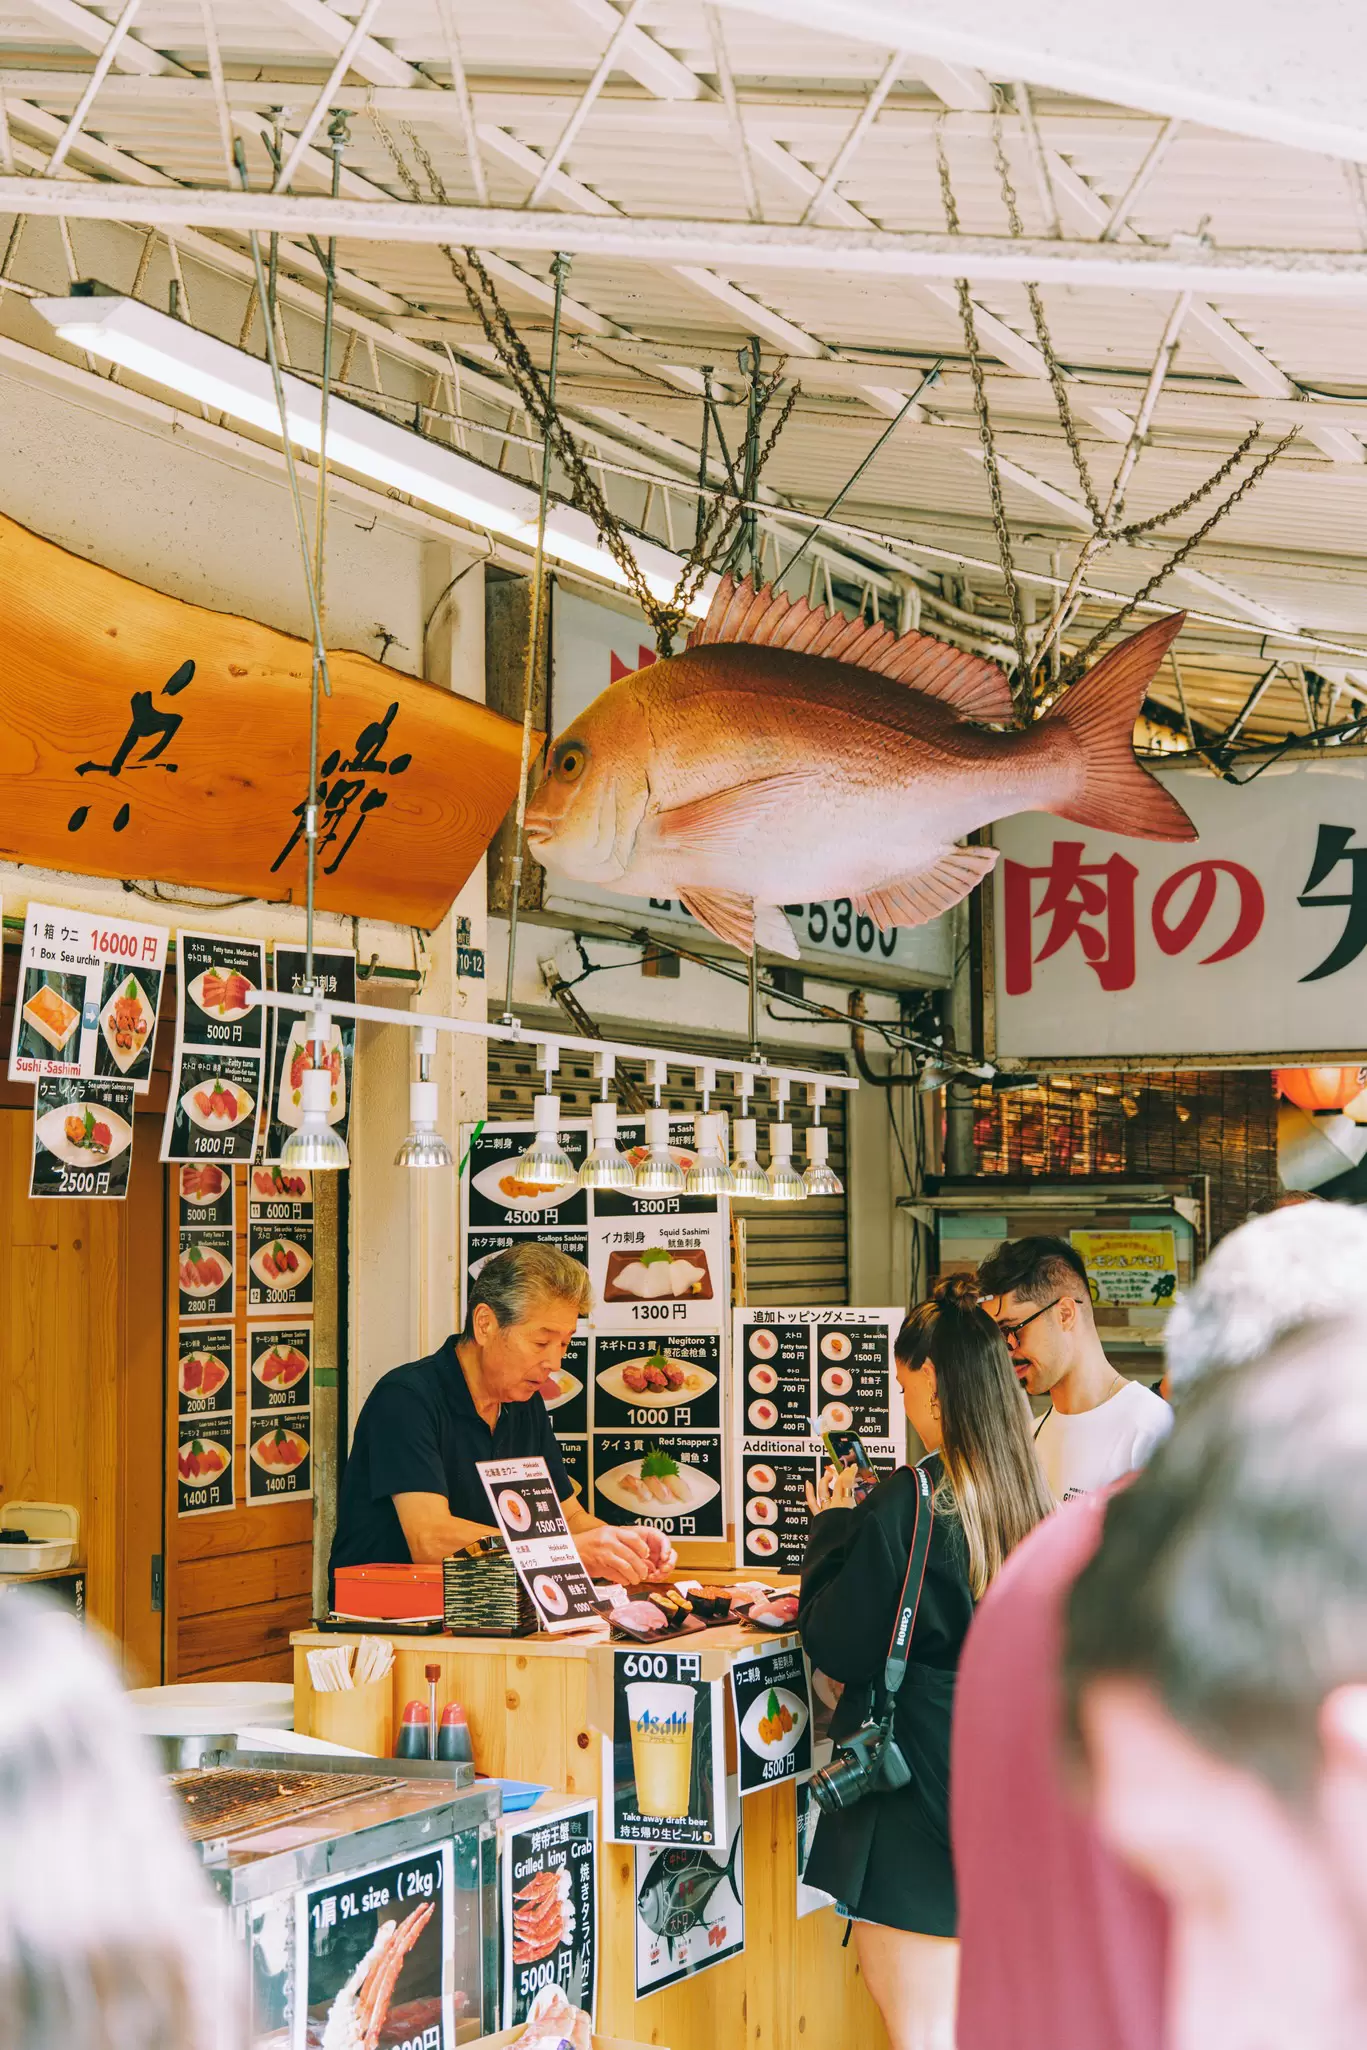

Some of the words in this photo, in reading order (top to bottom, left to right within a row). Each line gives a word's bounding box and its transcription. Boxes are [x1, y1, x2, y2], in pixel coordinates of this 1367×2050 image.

[33, 924, 38, 936] 1
[44, 924, 55, 940] 箱
[61, 927, 79, 942] ウニ
[91, 929, 138, 958] 16000
[141, 936, 158, 962] 円
[191, 943, 206, 952] 大トロ
[213, 945, 224, 954] Fatty
[40, 948, 56, 960] Box
[60, 950, 74, 964] Sea
[76, 953, 100, 967] urchin
[206, 1024, 230, 1041] 5000
[232, 1025, 242, 1042] 円
[16, 1058, 42, 1073] Sushi
[182, 1062, 196, 1070] 大トロ
[228, 1058, 242, 1068] Fatty
[242, 1060, 254, 1068] tuna
[40, 1082, 56, 1097] ウニ
[62, 1084, 86, 1098] イクラ
[194, 1137, 220, 1153] 1800
[222, 1136, 235, 1154] 円
[475, 1137, 512, 1150] ウニ刺身
[187, 1208, 207, 1221] 5000
[208, 1208, 216, 1222] 円
[267, 1204, 290, 1219] 6000
[292, 1203, 302, 1219] 円
[504, 1210, 540, 1224] 4500
[544, 1208, 558, 1224] 円
[538, 1234, 562, 1242] Scallops
[564, 1234, 588, 1243] Sashimi
[601, 1231, 646, 1244] イカ刺身
[660, 1228, 680, 1238] Squid
[682, 1228, 710, 1236] Sashimi
[472, 1237, 514, 1248] ホタテ刺身
[188, 1300, 206, 1312] 2800
[208, 1298, 216, 1312] 円
[753, 1310, 880, 1324] 追加トッピングメニュー
[668, 1336, 705, 1346] Negitoro
[710, 1336, 716, 1345] 3
[784, 1332, 802, 1340] 大トロ
[600, 1340, 636, 1351] ネギトロ
[712, 1348, 718, 1358] 3
[797, 1352, 804, 1360] 円
[874, 1354, 882, 1362] 円
[798, 1384, 805, 1392] 円
[875, 1390, 883, 1398] 円
[268, 1392, 286, 1404] 2000
[288, 1390, 296, 1404] 円
[187, 1400, 206, 1412] 2000
[208, 1397, 216, 1410] 円
[627, 1409, 668, 1426] 1000
[674, 1407, 691, 1426] 円
[797, 1422, 804, 1430] 円
[600, 1440, 619, 1452] タイ
[658, 1437, 675, 1446] Red
[676, 1438, 711, 1449] Snapper
[743, 1440, 805, 1453] Additional
[266, 1479, 286, 1492] 1400
[288, 1475, 296, 1490] 円
[797, 1484, 804, 1492] 円
[184, 1491, 208, 1506] 1400
[210, 1487, 220, 1504] 円
[536, 1520, 556, 1534] 1500
[556, 1518, 568, 1532] 円
[680, 1516, 696, 1534] 円
[800, 1516, 808, 1524] 円
[574, 1602, 590, 1613] 1000
[896, 1607, 912, 1646] Canon
[622, 1654, 668, 1678] 600
[676, 1654, 700, 1682] 円
[736, 1666, 760, 1686] ウニ刺身
[764, 1675, 773, 1686] Sea
[773, 1671, 786, 1682] urchin
[636, 1708, 688, 1736] Asahi
[762, 1759, 784, 1780] 4500
[786, 1752, 795, 1773] 円
[622, 1812, 642, 1822] Take
[642, 1814, 664, 1824] away
[666, 1814, 687, 1826] draft
[688, 1816, 708, 1826] beer
[620, 1824, 702, 1842] 持ち帰り生ビール
[514, 1857, 544, 1879] Grilled
[548, 1850, 566, 1867] king
[572, 1840, 592, 1859] Crab
[340, 1893, 360, 1919] 9L
[362, 1886, 390, 1912] size
[670, 1914, 688, 1931] 大トロ
[579, 1864, 590, 1997] 焼きタラバガニ
[520, 1960, 555, 1996] 5000
[558, 1950, 572, 1983] 円
